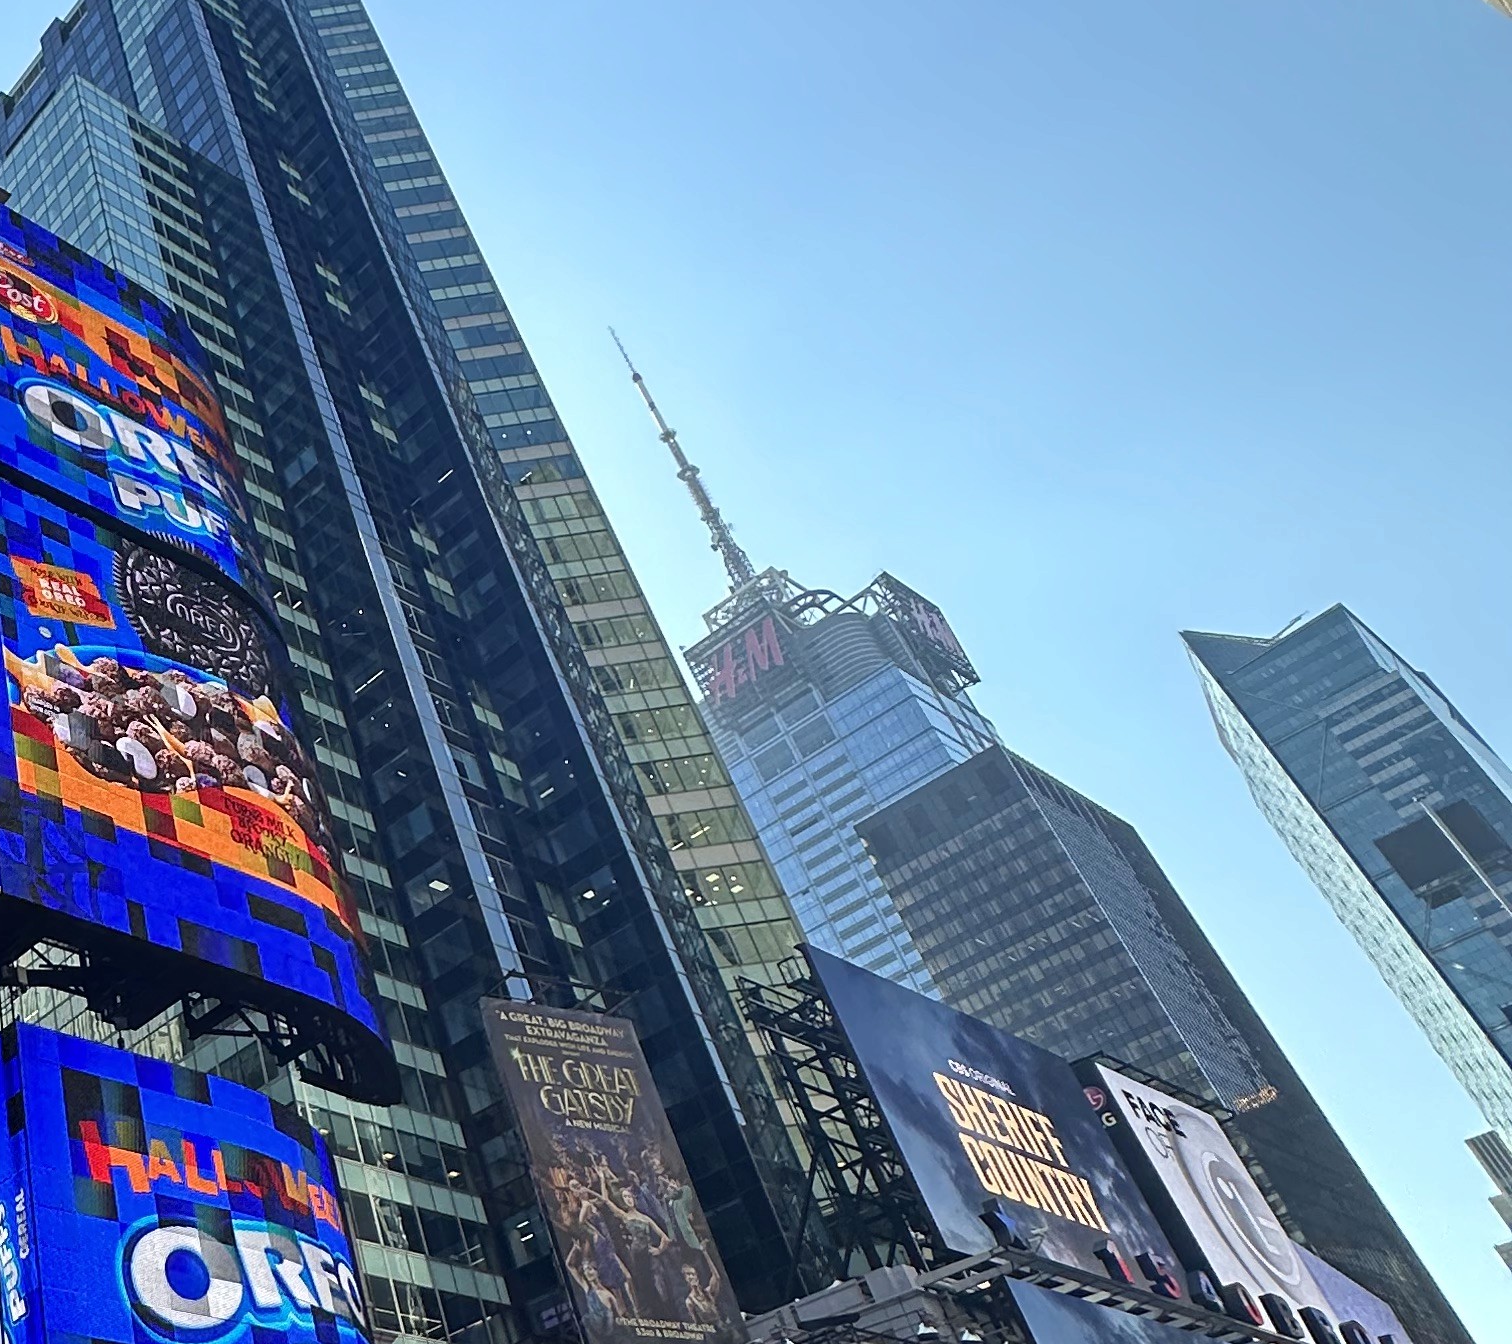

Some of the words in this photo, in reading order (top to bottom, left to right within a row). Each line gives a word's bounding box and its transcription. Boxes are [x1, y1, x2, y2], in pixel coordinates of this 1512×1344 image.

[38, 577, 82, 598] REAL
[41, 589, 86, 608] OREO
[709, 616, 785, 706] H&M
[525, 1024, 609, 1047] EXTRAVAGANZA
[548, 1017, 567, 1030] BIG
[568, 1019, 625, 1039] BROADWAY
[515, 1053, 559, 1086] THE
[562, 1058, 642, 1097] GREAT
[540, 1085, 635, 1125] GATSBY
[573, 1119, 593, 1130] NEW
[593, 1121, 632, 1135] MUSICAL
[933, 1071, 1071, 1168] SHERIFF
[1121, 1088, 1188, 1139] FACE
[958, 1132, 1111, 1234] COUNTRY
[14, 1186, 31, 1260] CEREAL
[130, 1225, 367, 1331] OREO
